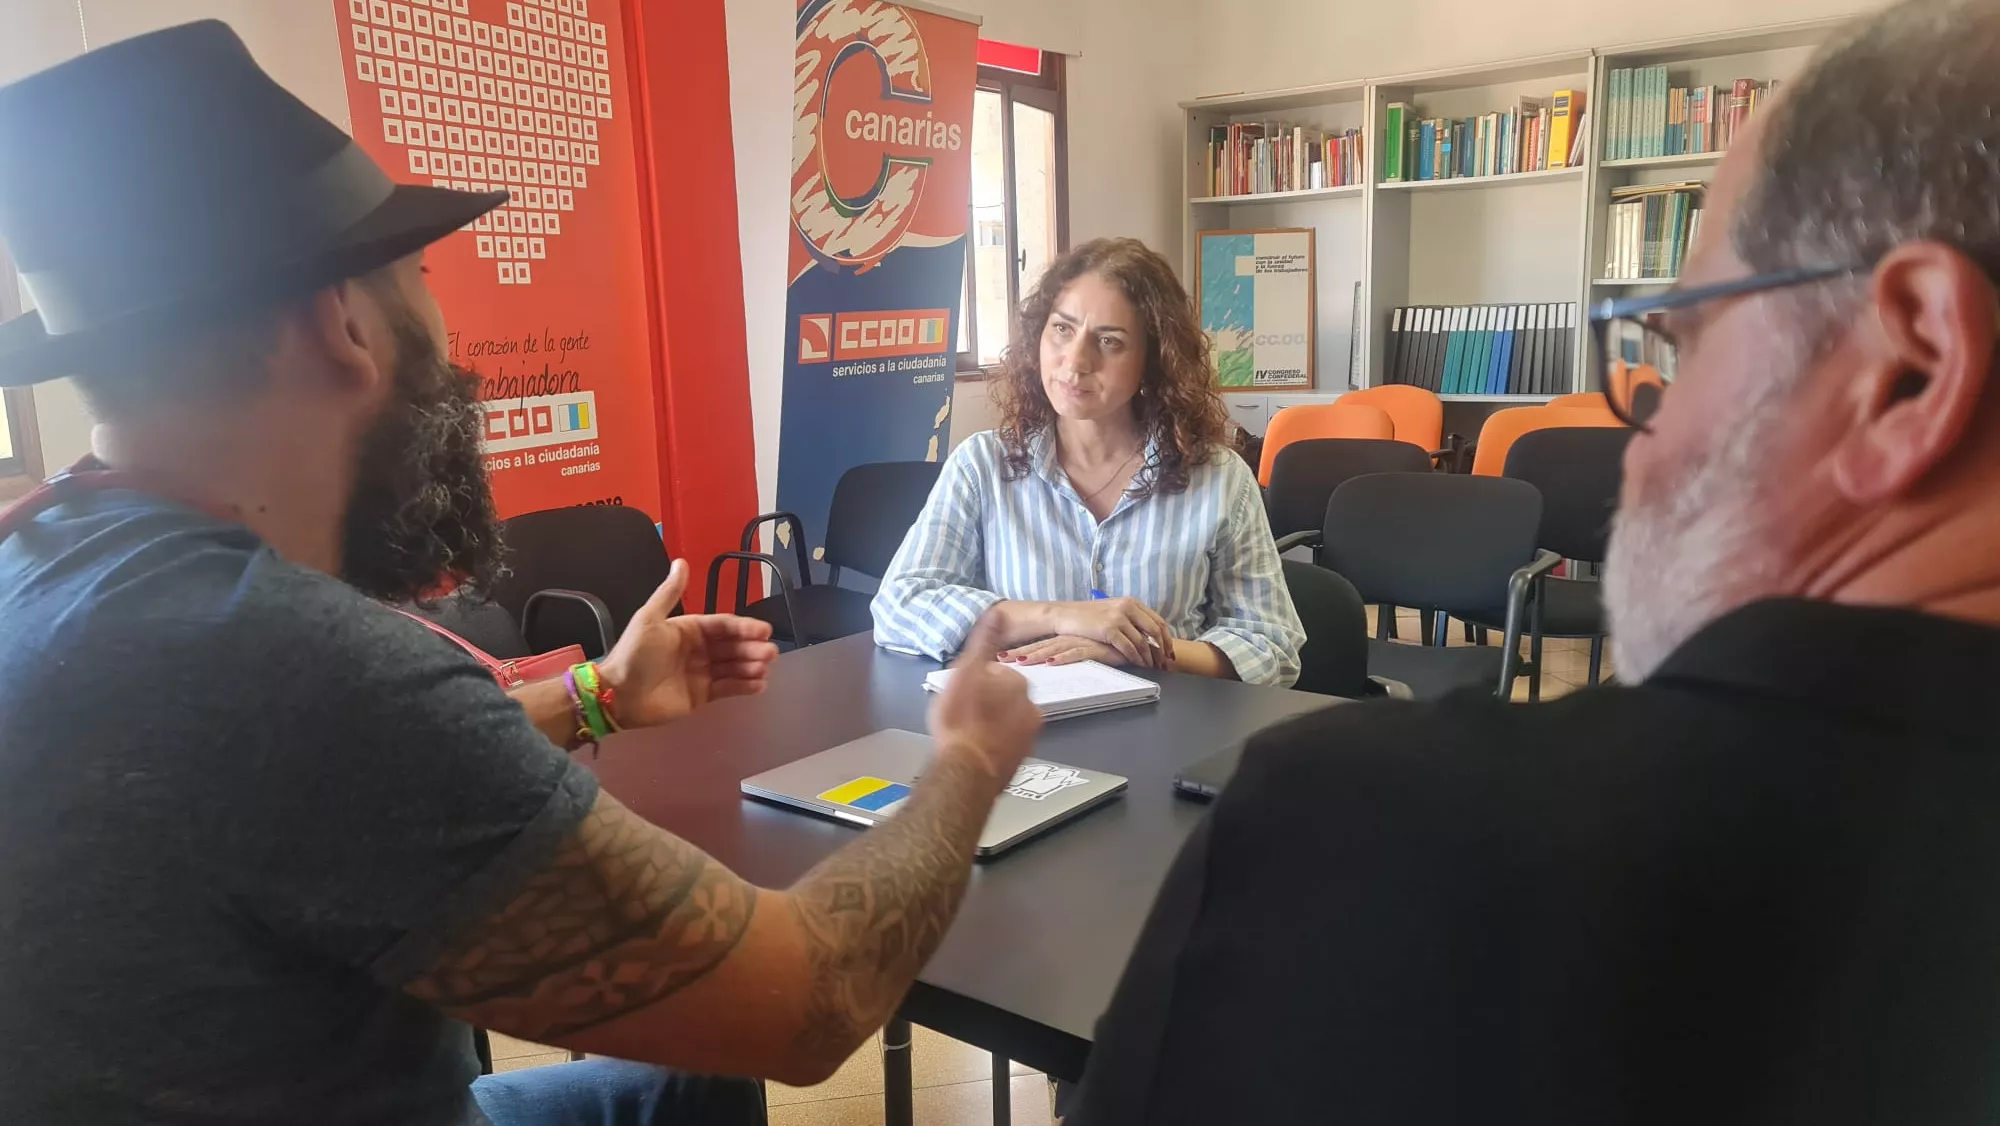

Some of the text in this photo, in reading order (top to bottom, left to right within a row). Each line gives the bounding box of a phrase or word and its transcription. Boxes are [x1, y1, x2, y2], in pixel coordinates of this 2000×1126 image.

[845, 108, 963, 151] canarias
[467, 334, 518, 357] corazón
[524, 333, 539, 354] de
[544, 327, 556, 351] la
[560, 330, 590, 364] gente
[840, 318, 915, 349] CCOO
[832, 355, 947, 378] servicios a la ciudadanía
[913, 372, 945, 384] canarias
[1255, 370, 1268, 379] IV
[483, 360, 582, 417] abajadora
[484, 405, 553, 441] COO
[514, 455, 522, 467] a
[524, 452, 535, 466] la
[538, 442, 600, 463] ciudadanía
[561, 461, 601, 476] canarias
